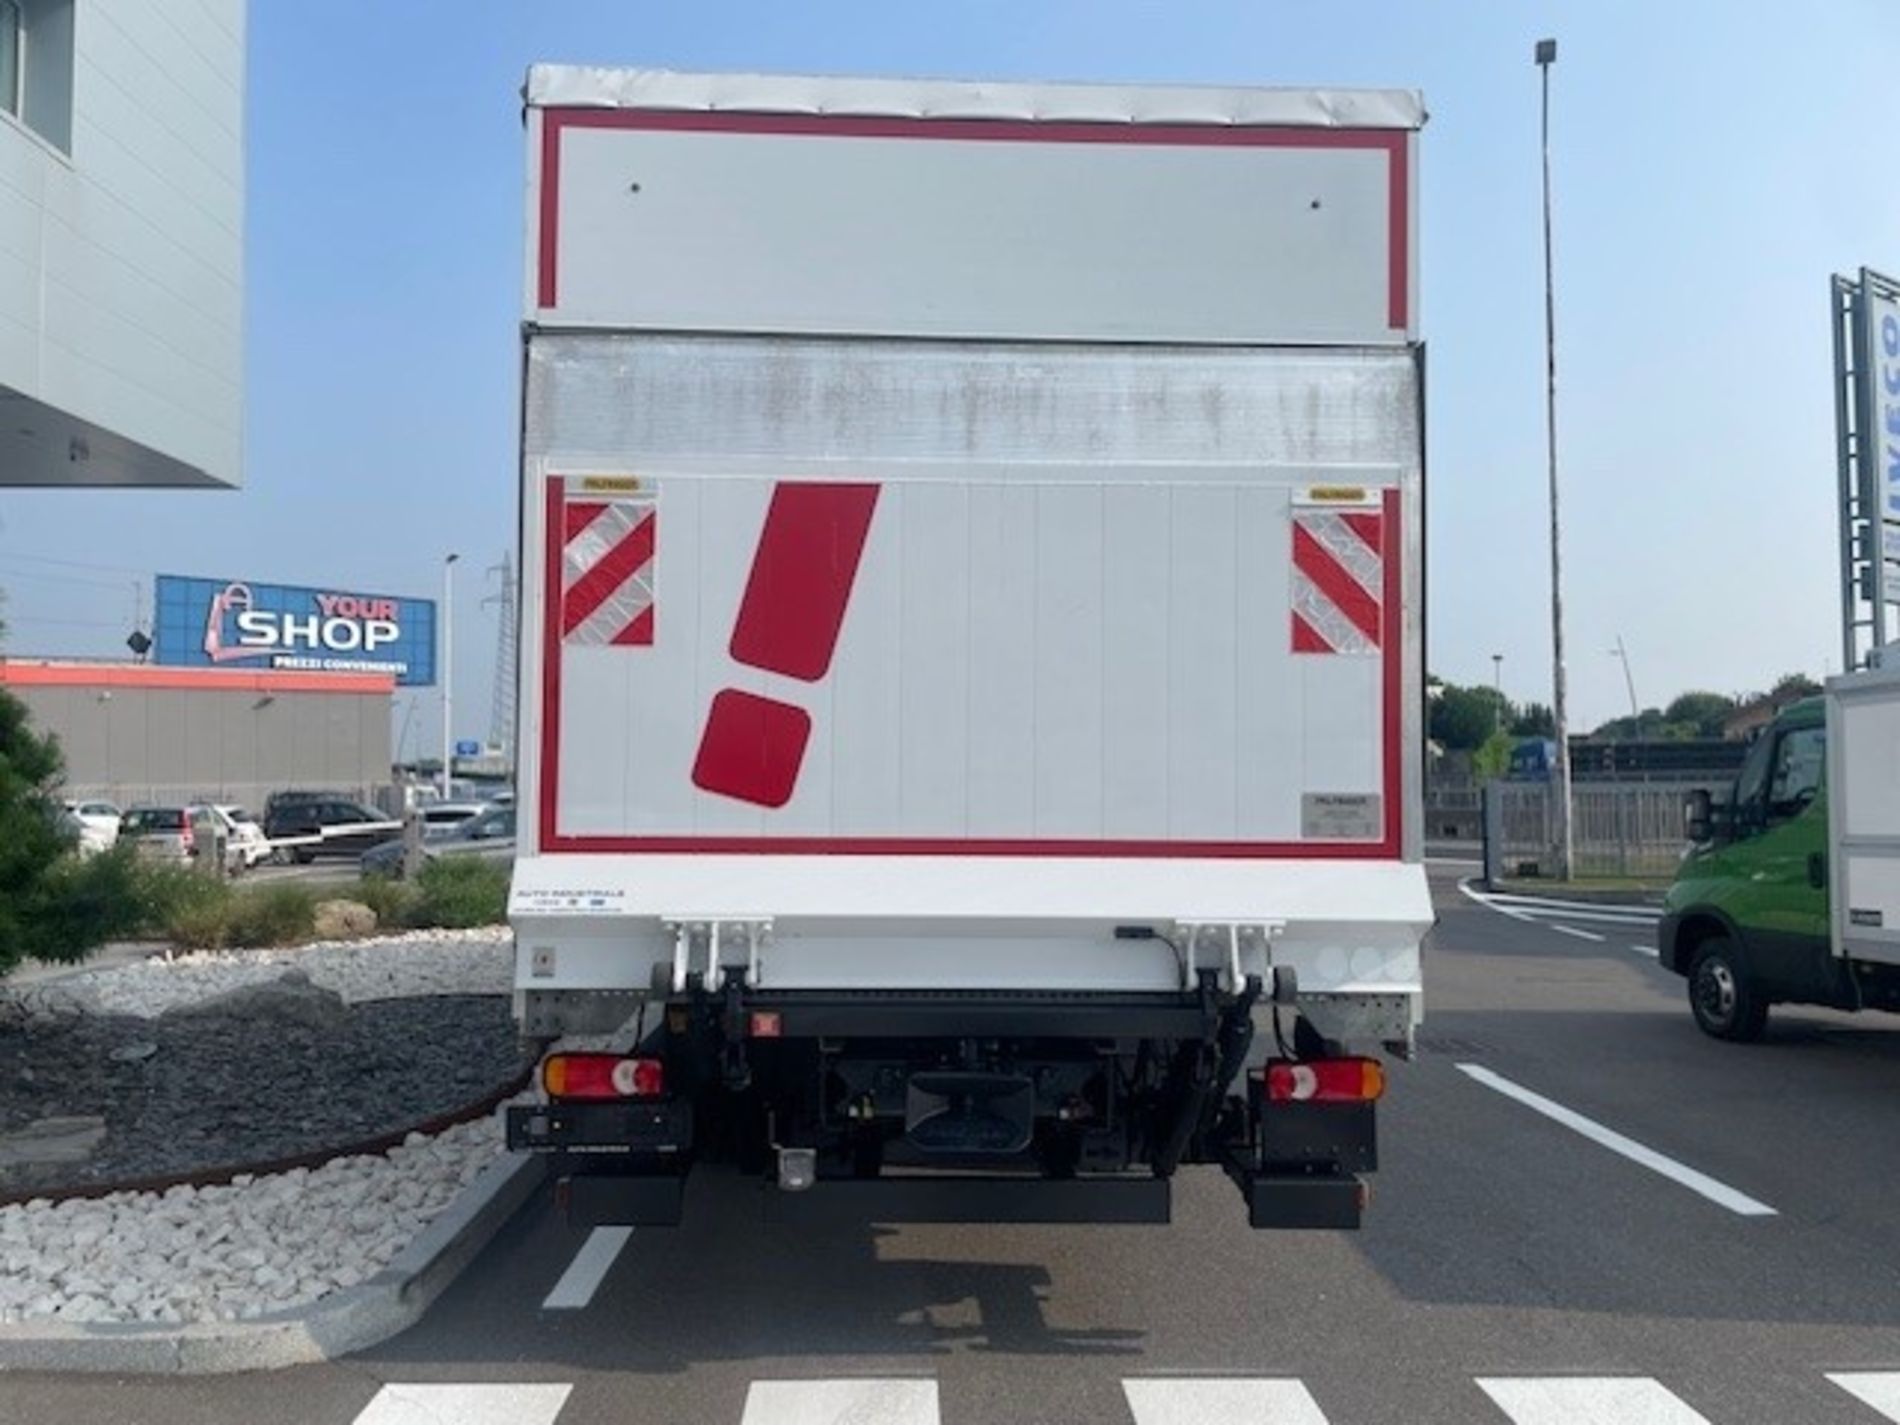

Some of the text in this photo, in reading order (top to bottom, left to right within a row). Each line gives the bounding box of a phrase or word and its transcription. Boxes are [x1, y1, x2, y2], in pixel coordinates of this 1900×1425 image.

[1882, 314, 1900, 512] IVECO
[316, 594, 397, 620] YOUR
[238, 611, 399, 652] SHOP
[274, 655, 321, 669] PREZZI
